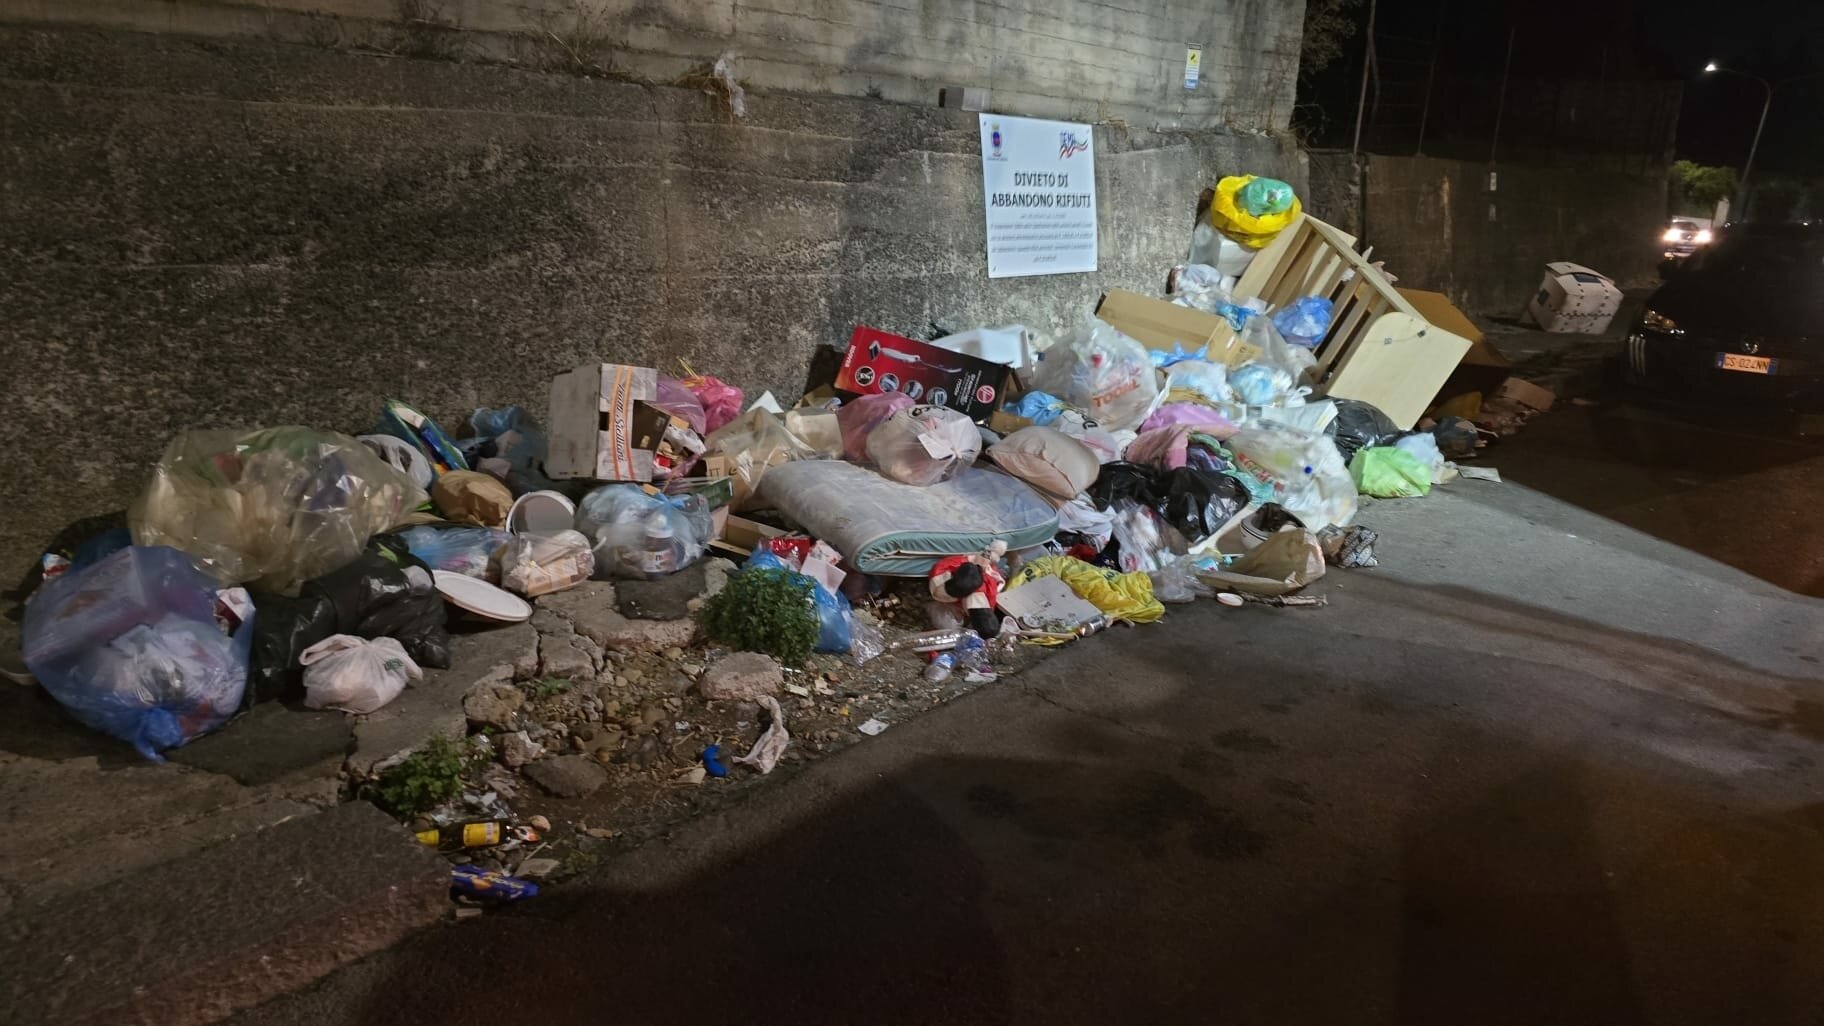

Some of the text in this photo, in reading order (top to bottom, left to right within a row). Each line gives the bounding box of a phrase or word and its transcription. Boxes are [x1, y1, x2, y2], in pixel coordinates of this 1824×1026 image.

[1014, 172, 1069, 188] DIVIETO DI
[991, 192, 1091, 208] ABBANDONO RIFIUTI
